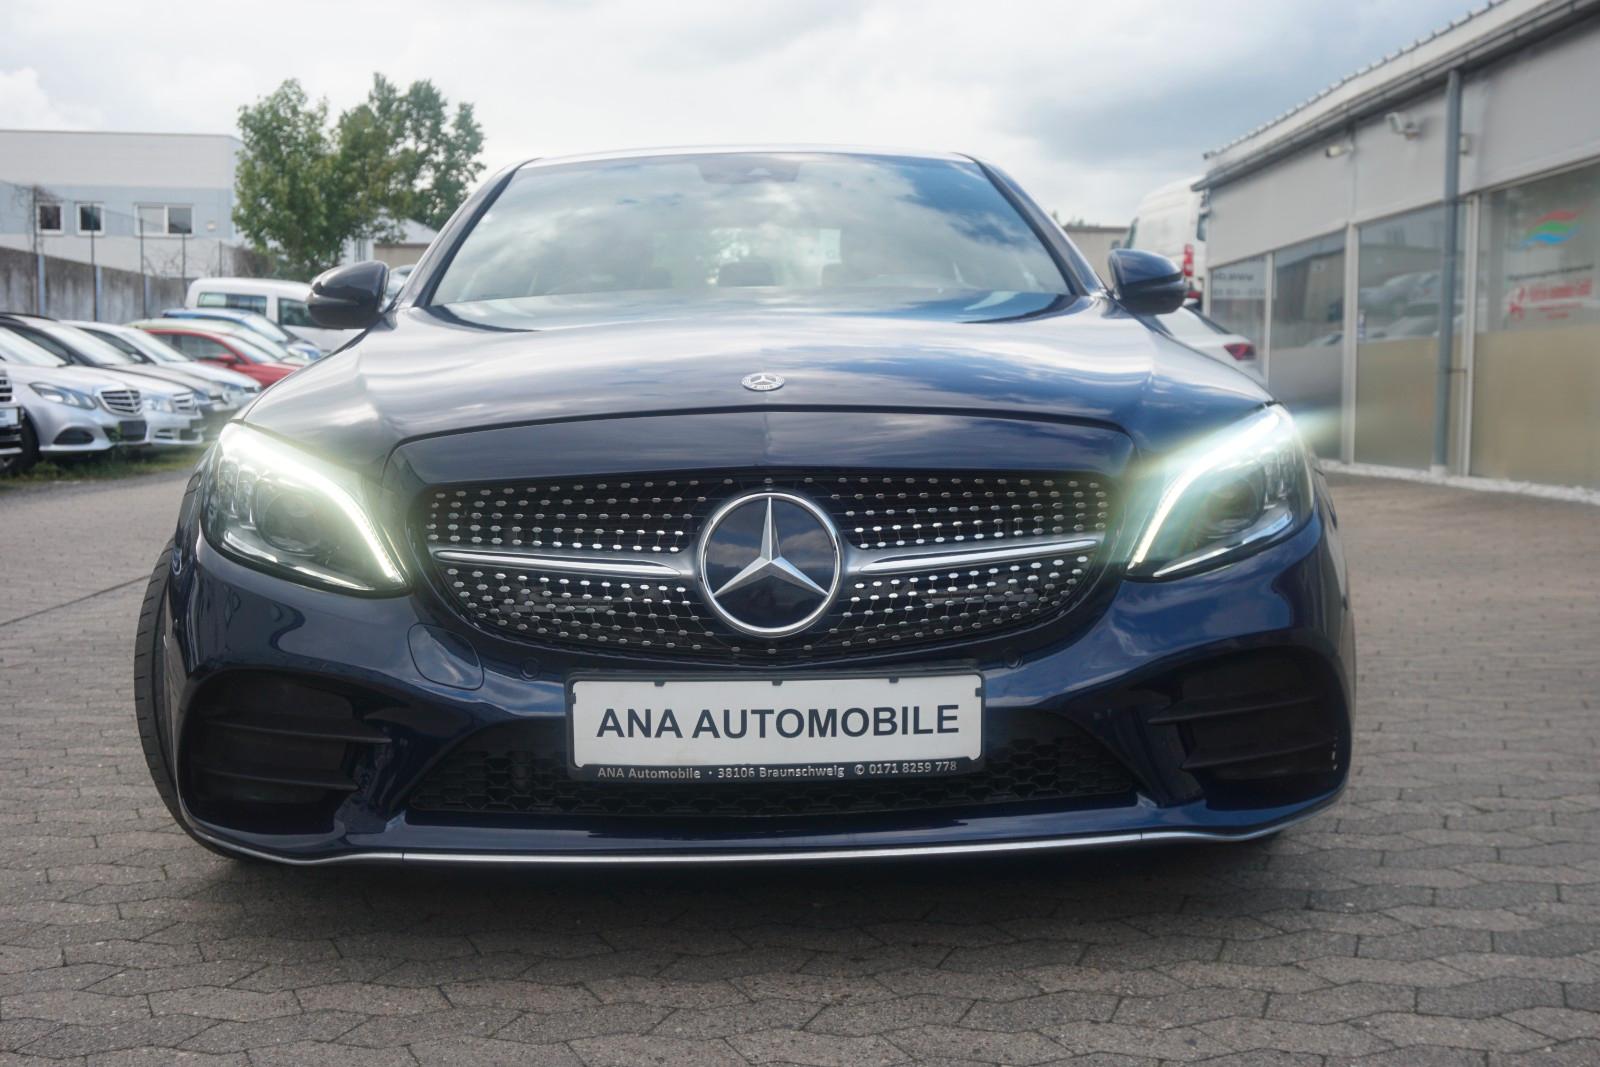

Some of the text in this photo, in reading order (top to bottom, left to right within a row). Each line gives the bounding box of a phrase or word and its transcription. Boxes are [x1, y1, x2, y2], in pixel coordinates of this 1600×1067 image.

[596, 704, 960, 739] ANA AUTOMOBILE
[597, 761, 957, 779] ANA Automobile 38106 Braunschweig 0171 8259 778
